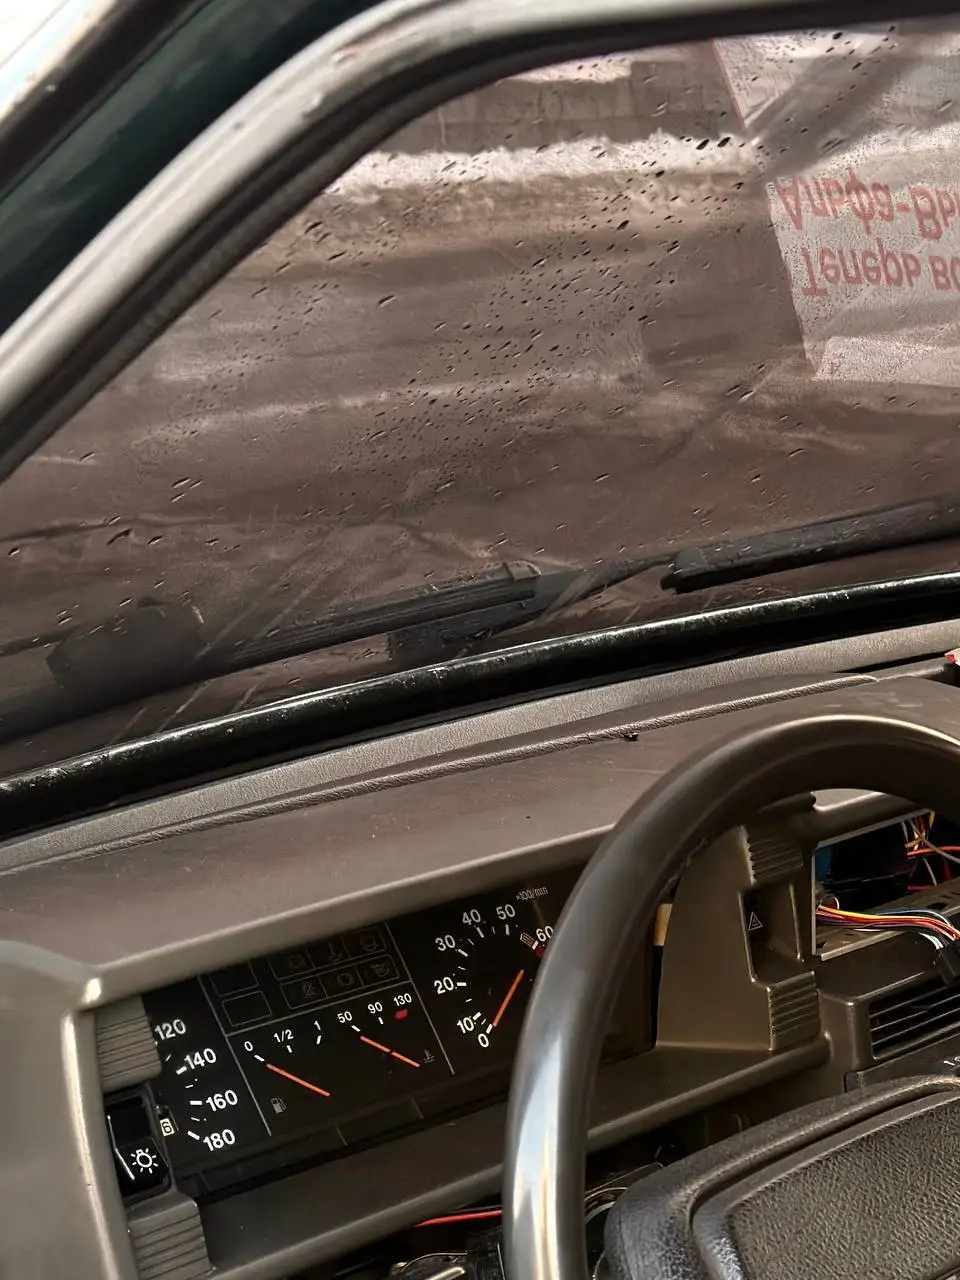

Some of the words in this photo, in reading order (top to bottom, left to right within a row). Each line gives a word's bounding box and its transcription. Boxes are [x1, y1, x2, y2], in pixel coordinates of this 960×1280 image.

[462, 908, 481, 926] 40
[495, 903, 516, 920] 50
[435, 934, 456, 952] 30
[535, 925, 554, 942] 60
[434, 976, 454, 995] 20
[337, 1011, 353, 1024] 50
[367, 1001, 383, 1014] 90
[392, 992, 412, 1007] 130
[154, 1019, 187, 1041] 120
[456, 1016, 475, 1034] 10
[243, 1040, 254, 1052] 0
[273, 1029, 294, 1043] 1/2
[313, 1020, 322, 1031] 1
[477, 1033, 490, 1048] 0
[183, 1048, 217, 1070] 140
[205, 1089, 238, 1112] 160
[203, 1129, 236, 1152] 180
